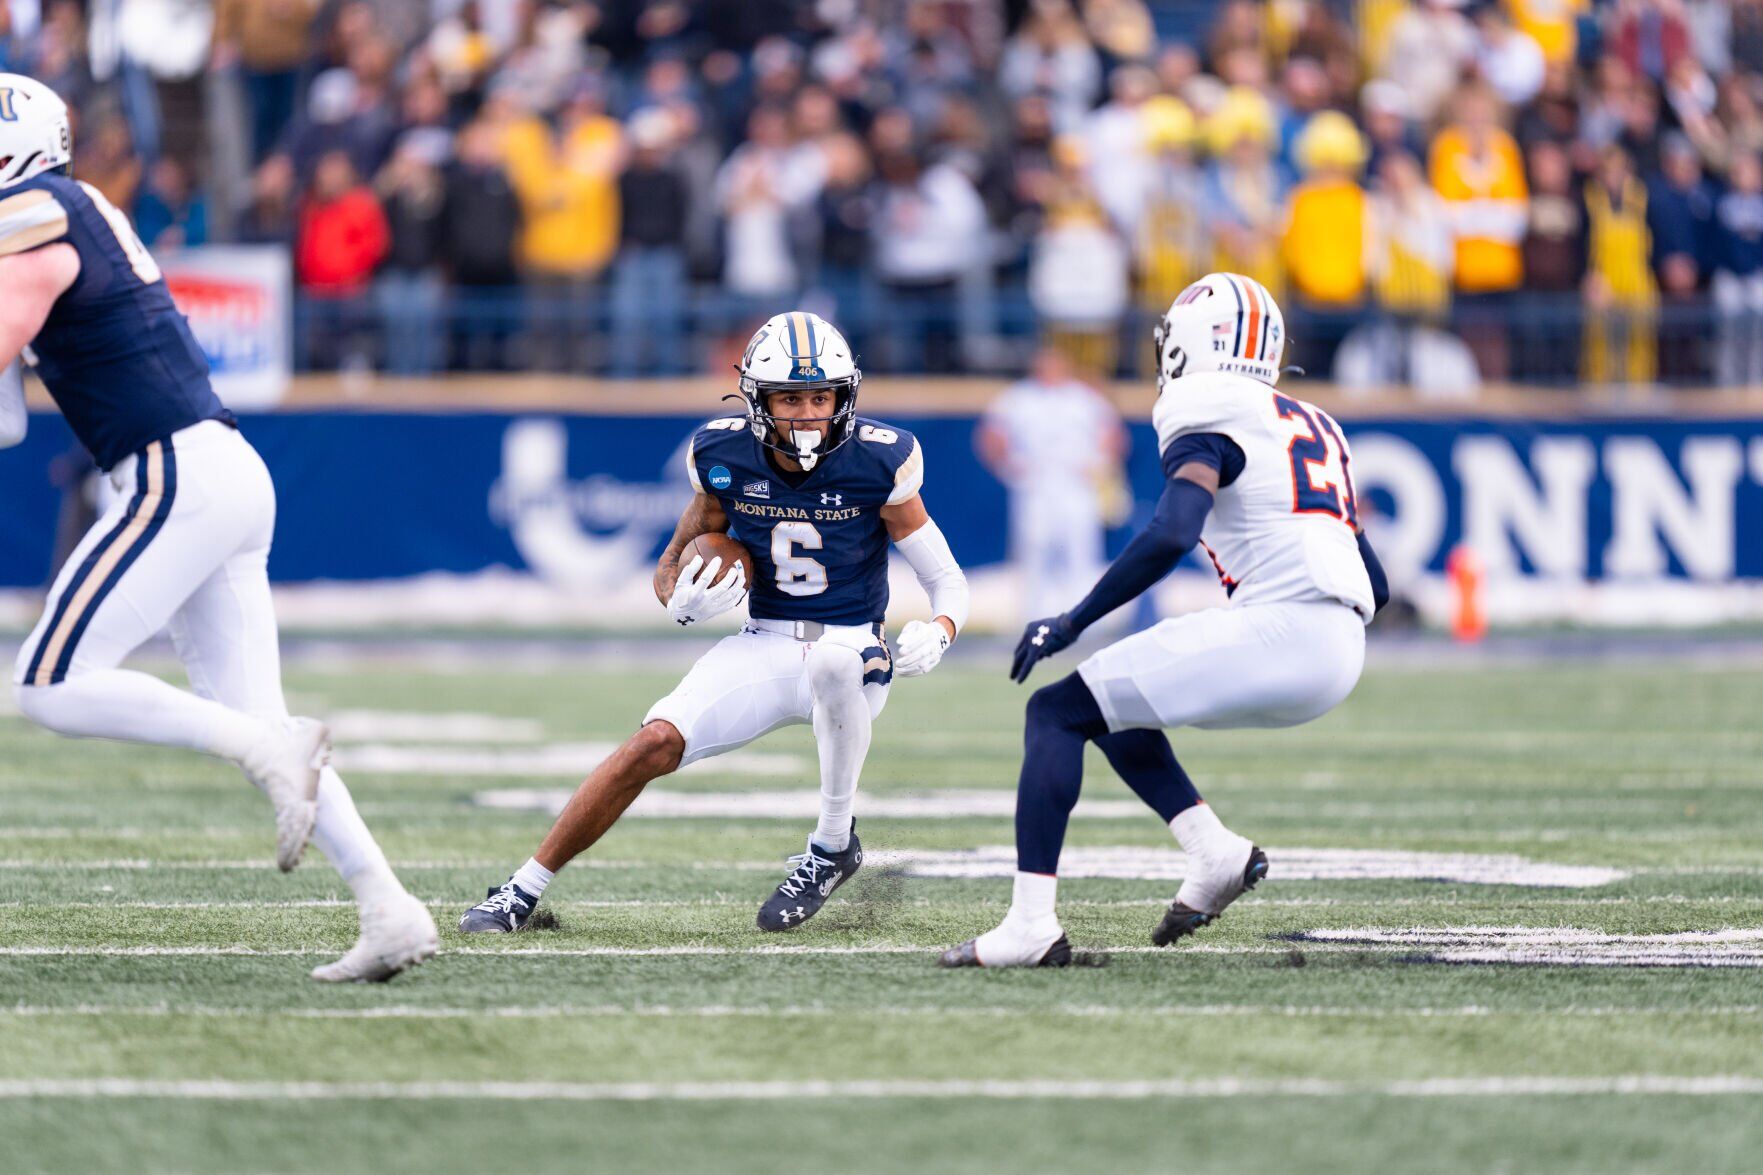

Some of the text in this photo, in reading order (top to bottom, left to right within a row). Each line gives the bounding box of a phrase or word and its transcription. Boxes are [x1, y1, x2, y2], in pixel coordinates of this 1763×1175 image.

[1213, 340, 1225, 351] 21
[798, 366, 818, 377] 406
[706, 417, 747, 432] 6
[858, 424, 899, 445] 6
[712, 476, 731, 484] NCAA
[734, 500, 861, 521] MONTANA STATE
[1348, 430, 1763, 583] ONN
[770, 521, 829, 597] 6
